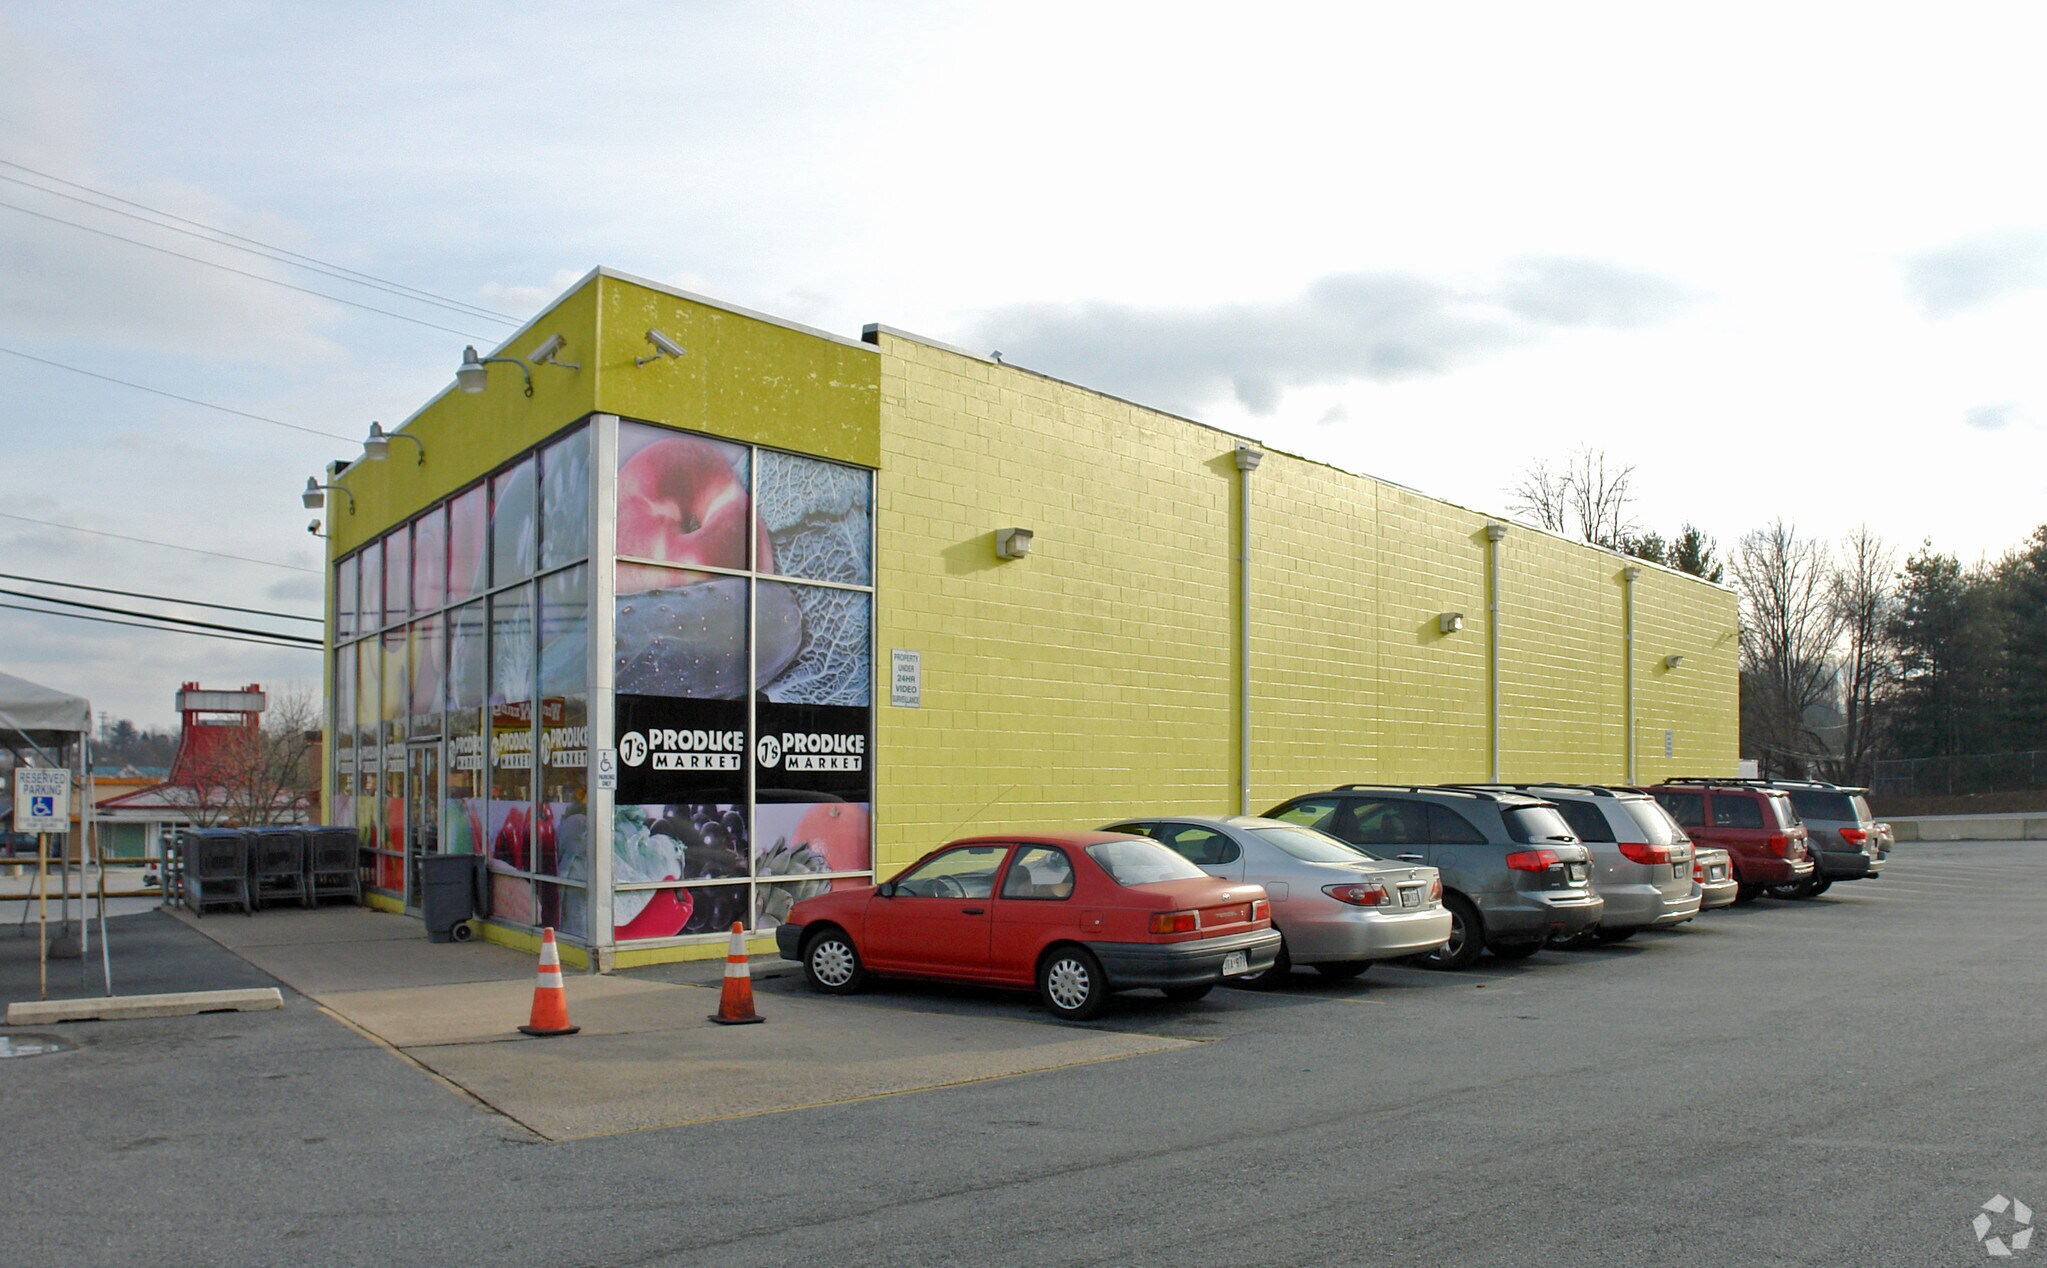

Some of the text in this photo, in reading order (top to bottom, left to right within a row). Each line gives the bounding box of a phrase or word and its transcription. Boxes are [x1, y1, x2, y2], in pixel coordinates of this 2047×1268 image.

[894, 653, 918, 662] PROPERTY
[898, 664, 915, 672] UNDER
[897, 674, 916, 683] 24HR
[896, 685, 917, 694] VIDEO
[649, 728, 744, 752] PRODUCE
[782, 732, 864, 754] PRODUCE
[553, 752, 587, 766] MARKET
[655, 755, 739, 768] MARKET
[788, 756, 860, 769] MARKET
[19, 772, 66, 784] RESERVED
[22, 783, 62, 796] PARKING
